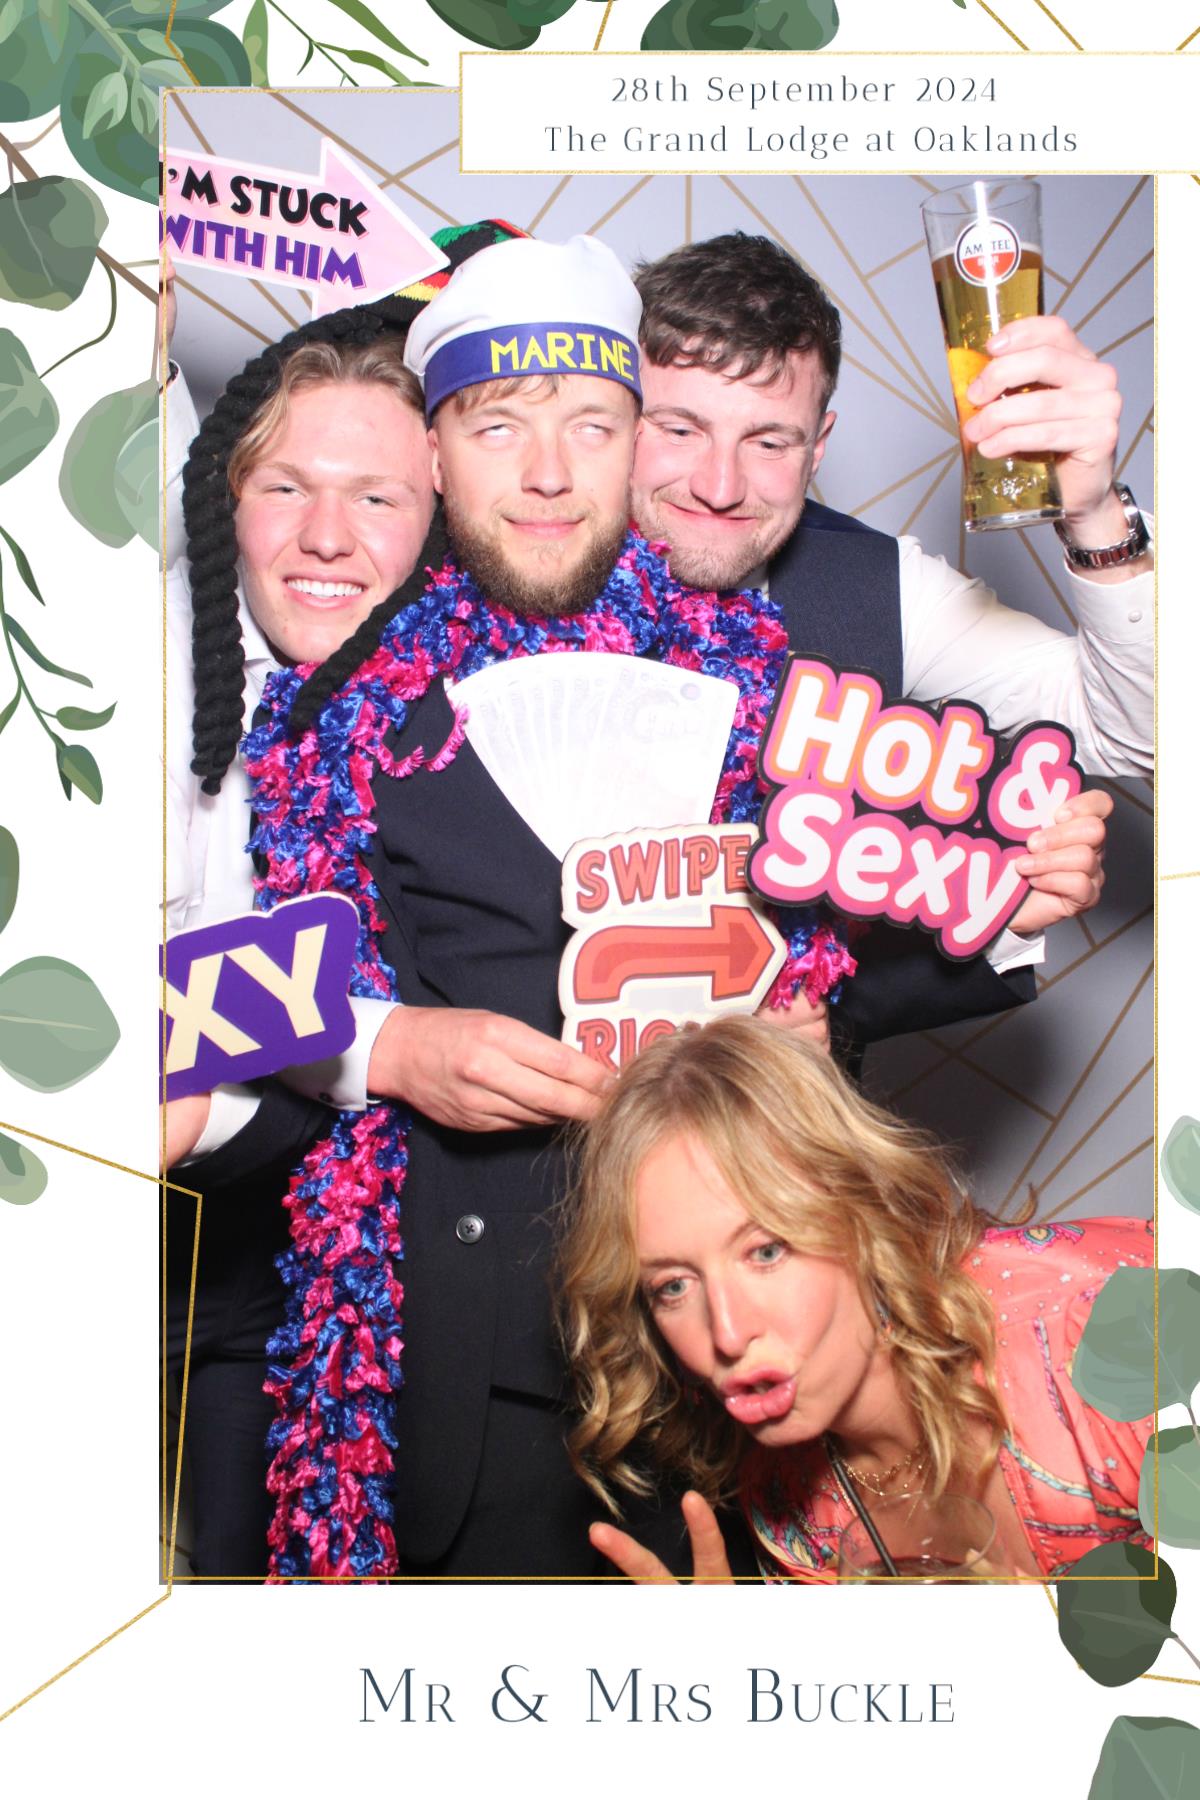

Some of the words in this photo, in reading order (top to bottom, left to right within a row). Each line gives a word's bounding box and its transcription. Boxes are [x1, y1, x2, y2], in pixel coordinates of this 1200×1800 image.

[230, 175, 369, 237] STUCK
[159, 210, 267, 269] WITH
[274, 235, 367, 289] HIM
[964, 239, 1011, 256] AMTEL
[490, 332, 634, 381] MARINE
[776, 674, 984, 812] Hot
[576, 834, 752, 913] SWIPE
[763, 793, 1025, 944] Sexy
